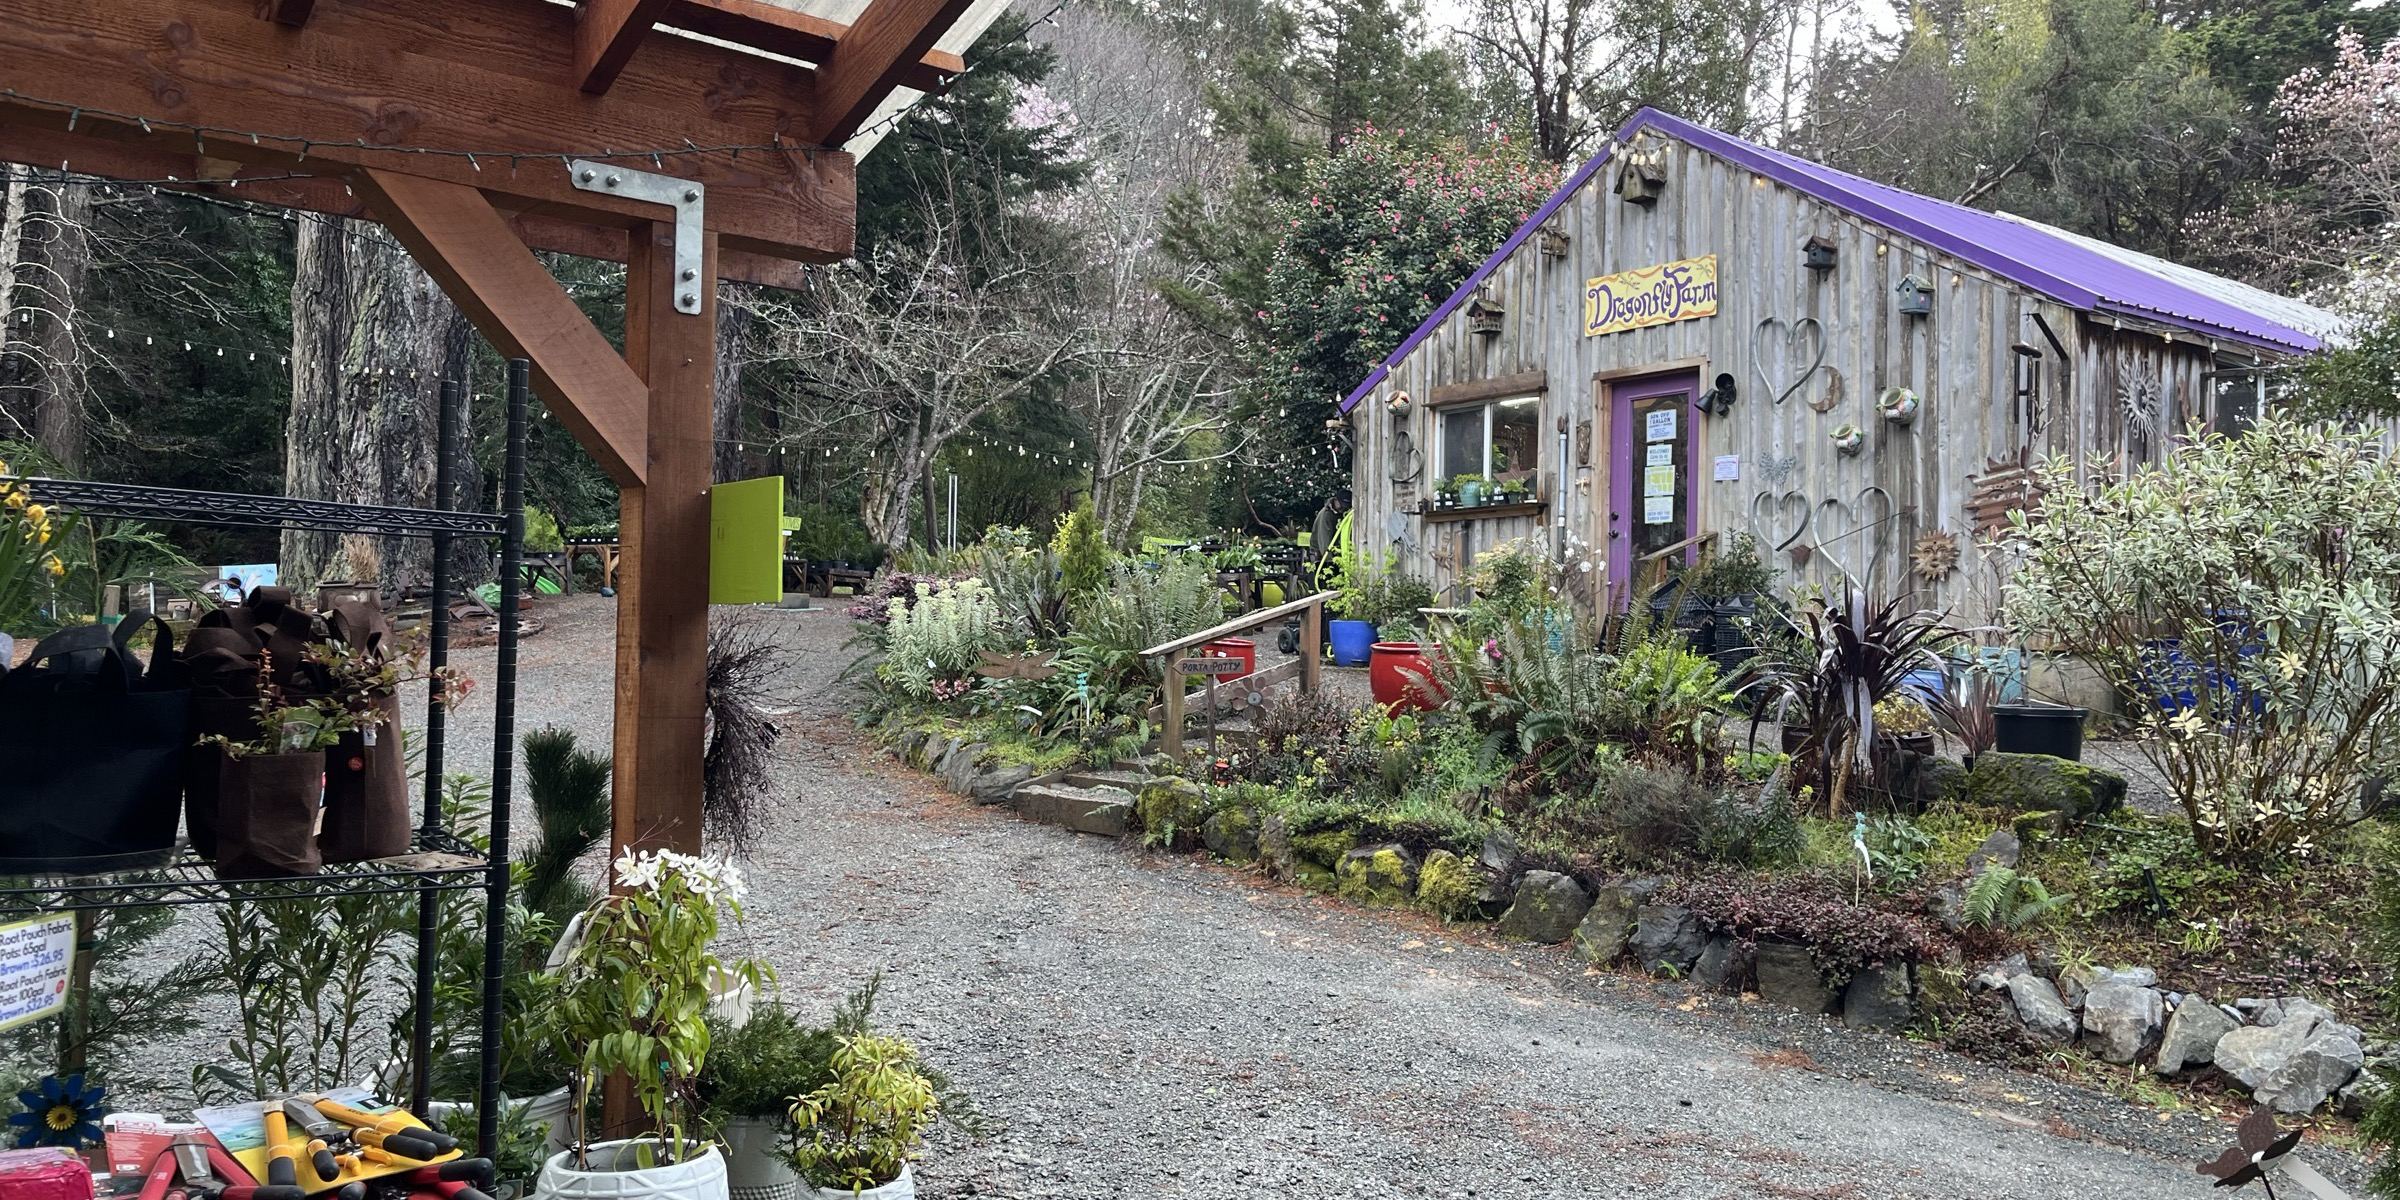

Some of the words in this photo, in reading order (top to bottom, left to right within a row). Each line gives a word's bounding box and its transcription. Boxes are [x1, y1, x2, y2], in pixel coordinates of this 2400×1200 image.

[1588, 279, 1675, 330] Dragonfly
[1663, 266, 1718, 318] Farm
[1182, 662, 1208, 672] PORTA
[1212, 661, 1241, 672] POTTY
[0, 933, 19, 946] Root
[21, 924, 47, 941] Pouch
[47, 920, 72, 935] Fabric
[0, 948, 21, 961] Pots:
[23, 938, 47, 955] 65gal
[0, 961, 30, 976] Brown
[20, 971, 44, 987] Pouch
[44, 965, 67, 980] Fabric
[19, 983, 46, 1001] 100gal
